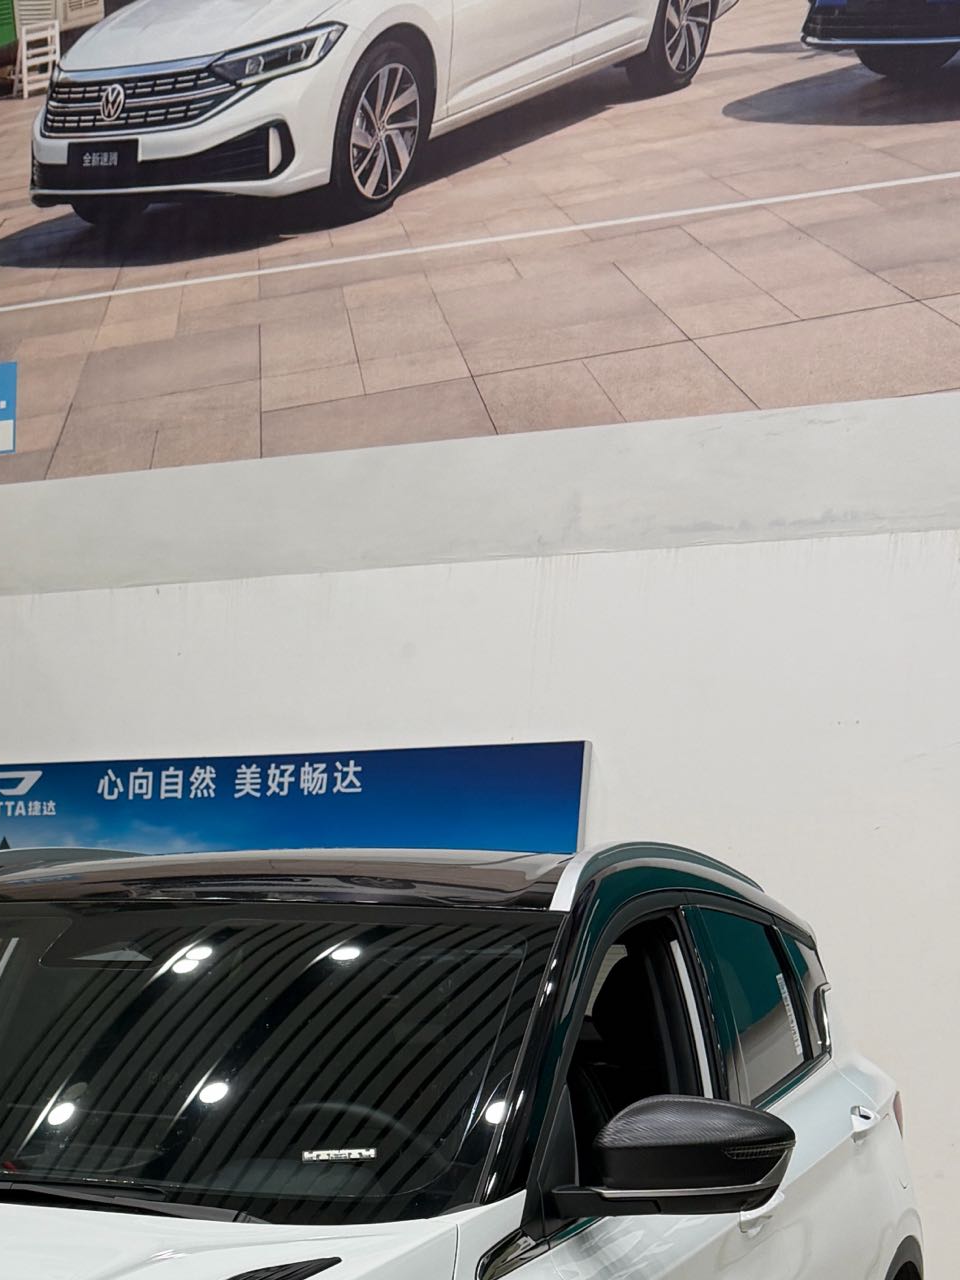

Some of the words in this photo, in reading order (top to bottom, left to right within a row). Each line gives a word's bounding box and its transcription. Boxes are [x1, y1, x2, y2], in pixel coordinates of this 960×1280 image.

[97, 765, 217, 801] 心向自然
[234, 760, 362, 799] 美好畅达
